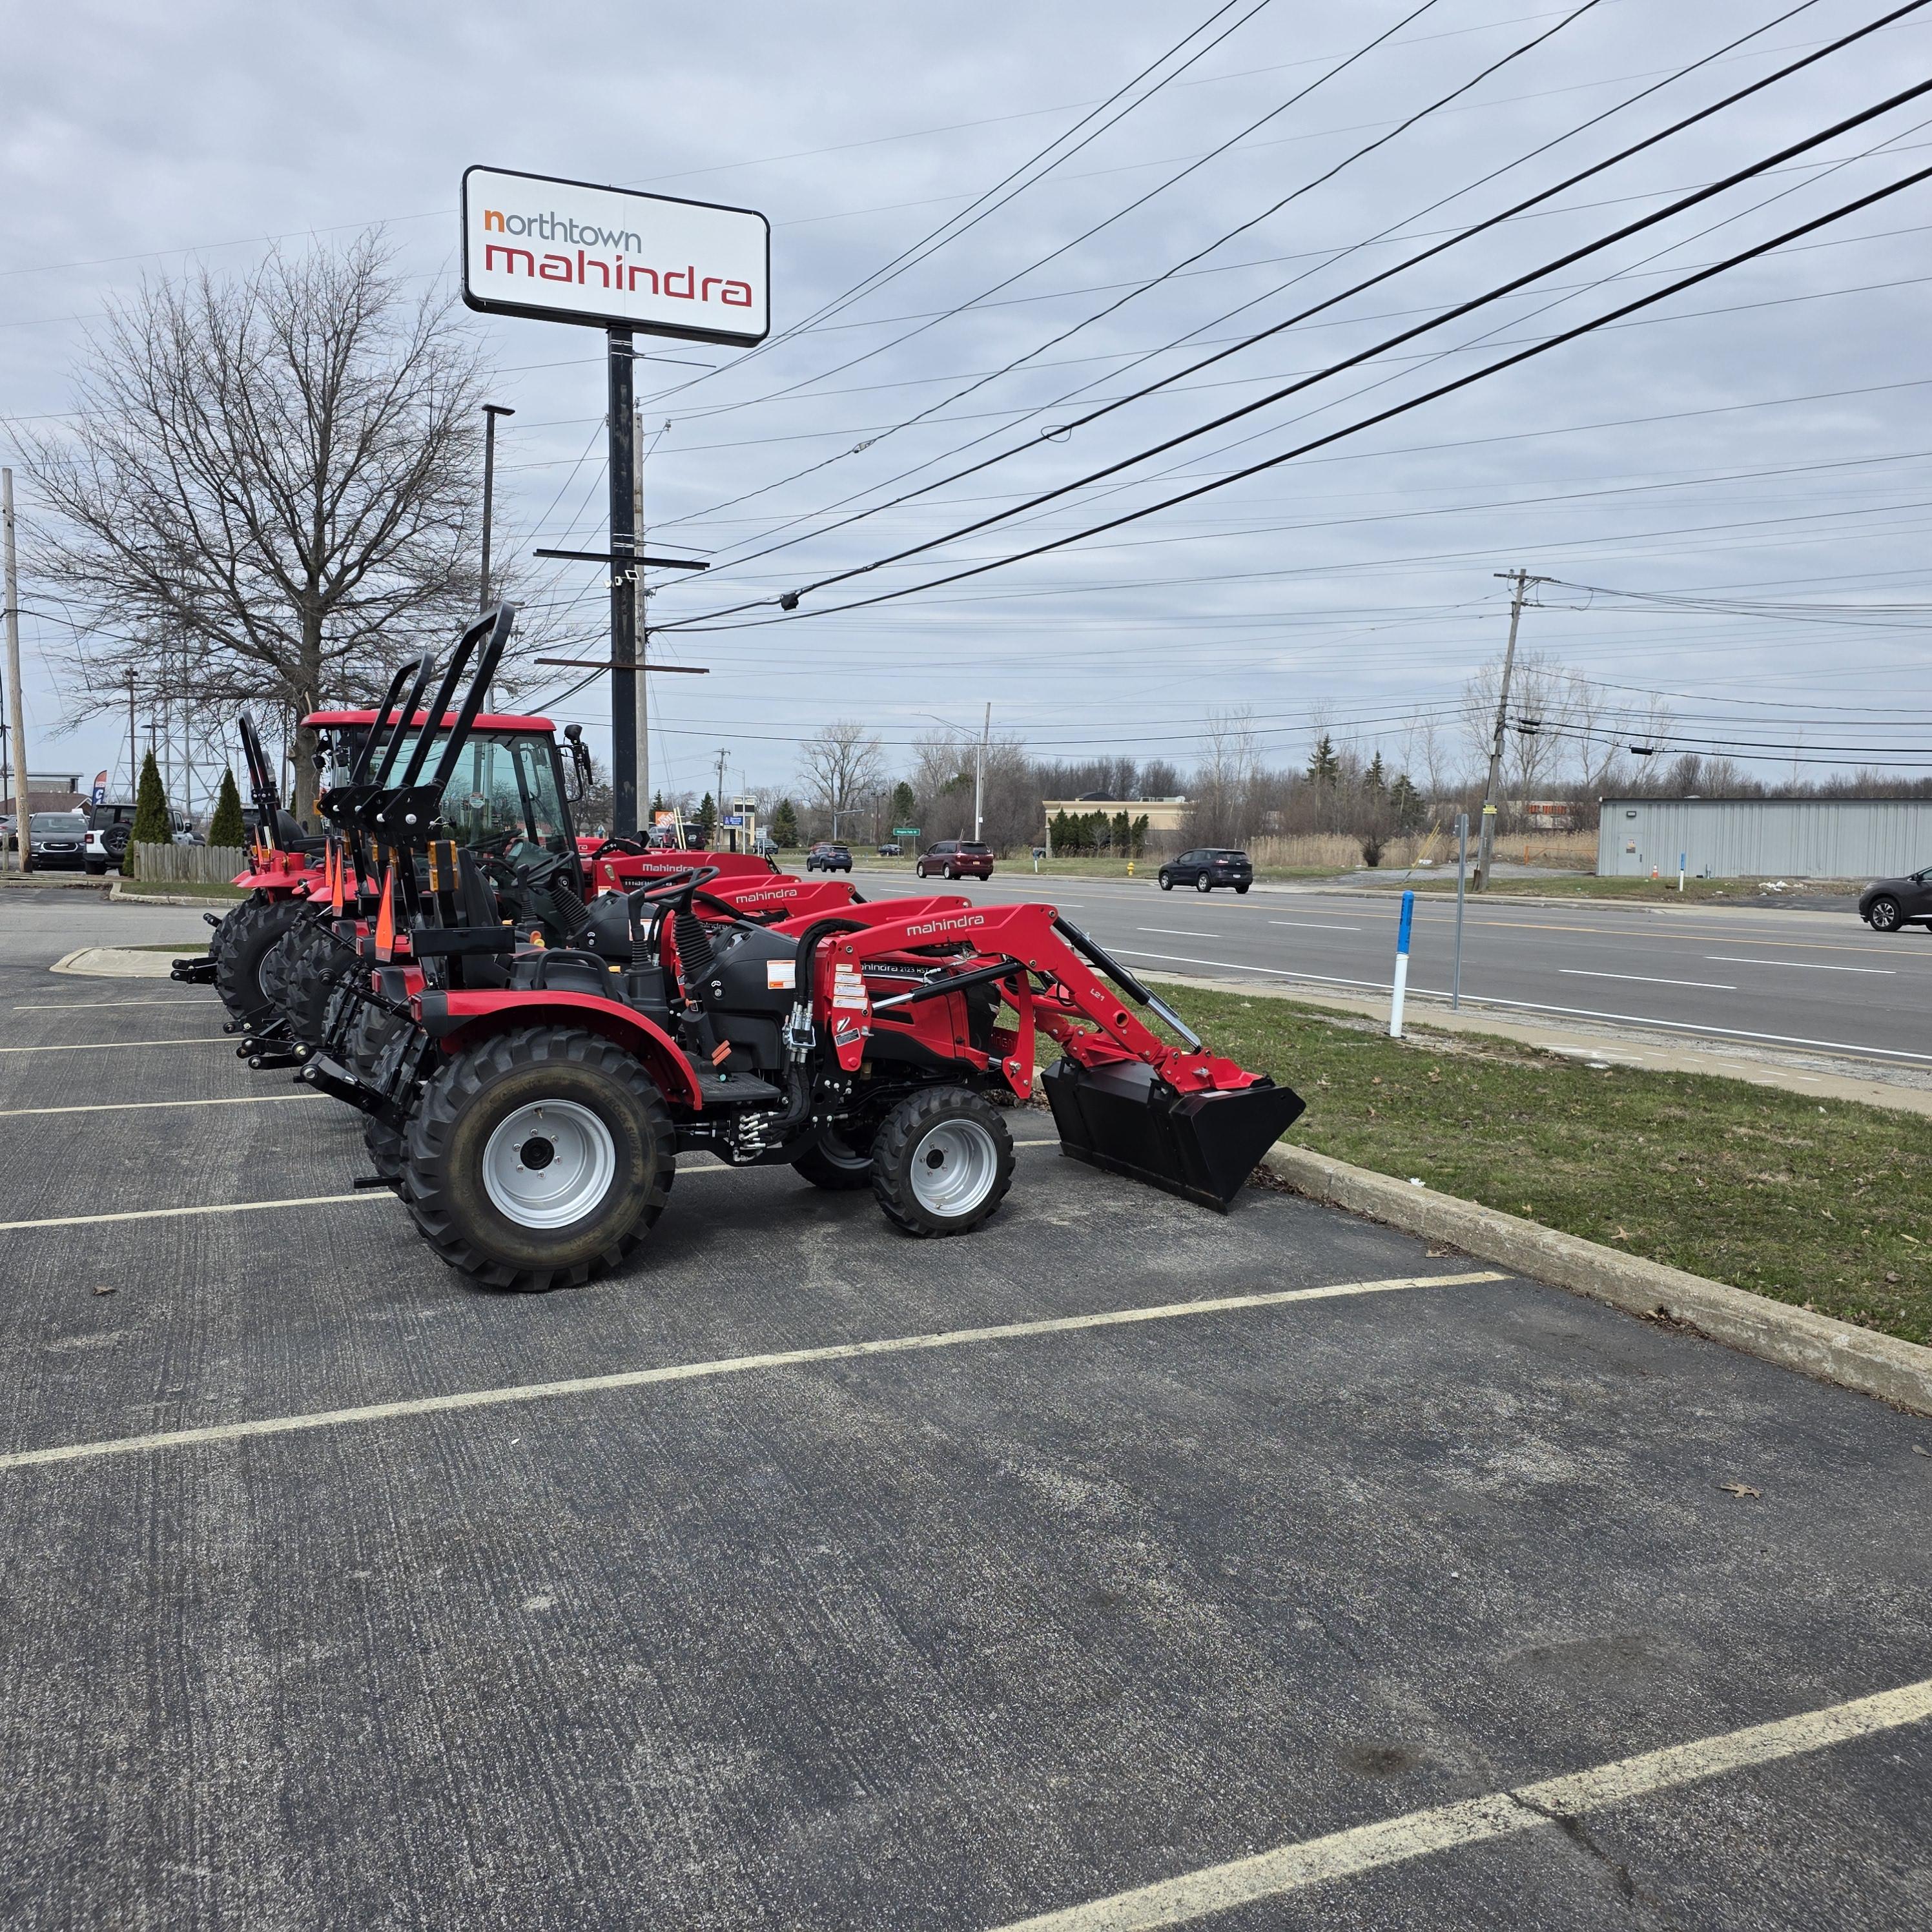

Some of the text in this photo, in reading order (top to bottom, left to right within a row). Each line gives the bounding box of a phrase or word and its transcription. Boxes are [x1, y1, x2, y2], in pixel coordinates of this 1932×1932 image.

[485, 210, 641, 253] northtown
[486, 244, 752, 307] mahindra
[736, 889, 797, 904] mahindra
[907, 915, 984, 936] mahindra
[1090, 988, 1105, 1002] L21
